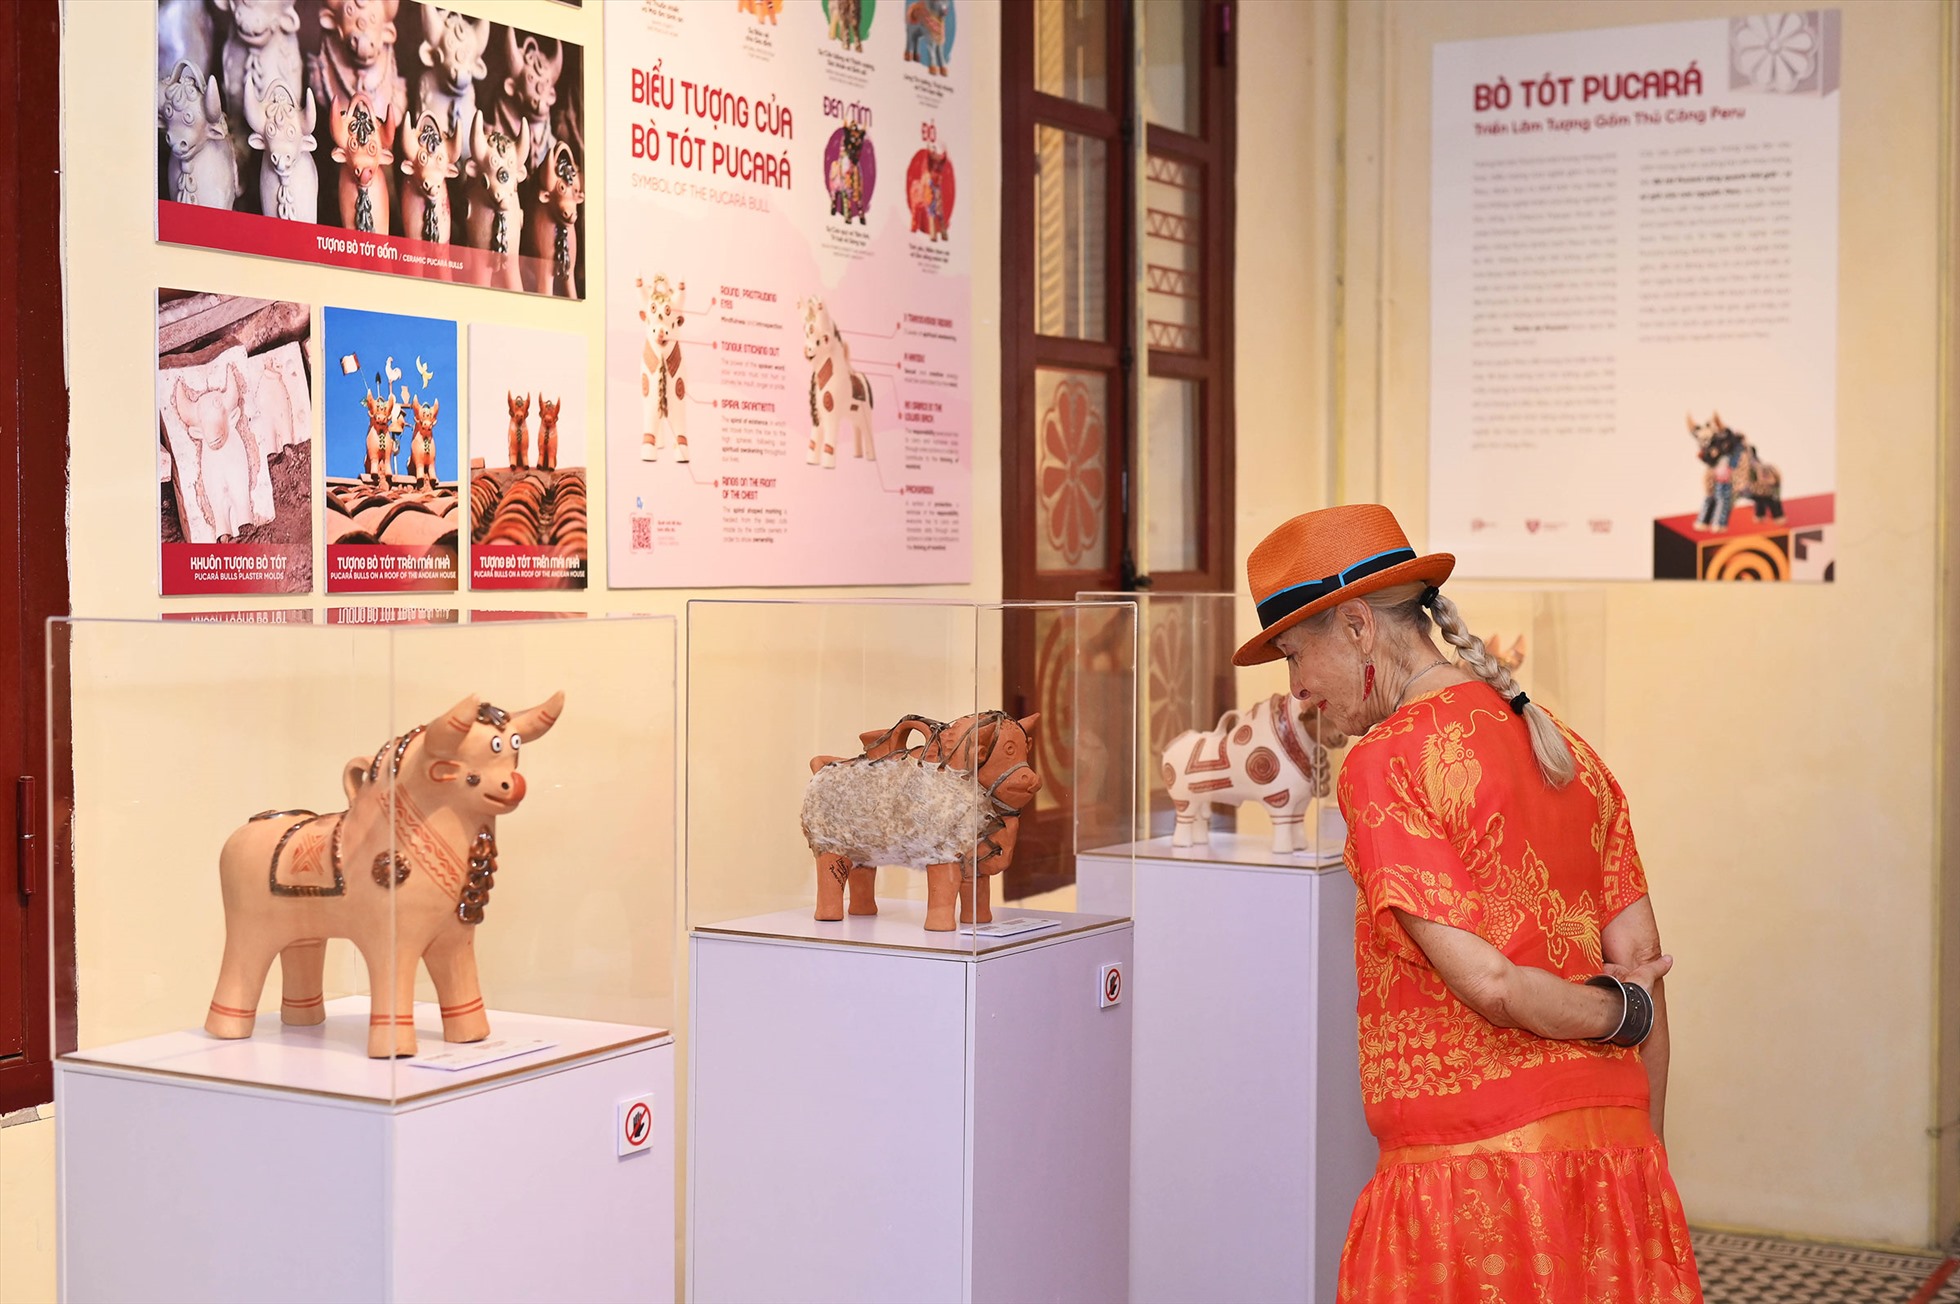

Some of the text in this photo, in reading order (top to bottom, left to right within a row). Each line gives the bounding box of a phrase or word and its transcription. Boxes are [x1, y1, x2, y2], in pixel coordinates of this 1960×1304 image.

[1474, 60, 1703, 112] BÒ TÓT PUCARÁ
[632, 58, 792, 140] BIỂU TƯỢNG CỦA
[632, 118, 791, 190] BÒ TÓT PUCARÁ
[317, 237, 345, 253] TƯỢNG
[347, 239, 358, 254] BÒ
[360, 242, 375, 257] TÓT
[377, 242, 398, 260] GỐM
[402, 254, 426, 264] CERAMIC
[448, 260, 463, 269] BULLS
[190, 554, 287, 572] KHUÔN TƯỢNG BÒ TÓT
[337, 554, 450, 571] TƯỢNG BÒ TÓT TRÊN MÁI NHÀ
[480, 556, 504, 570] TƯỢNG
[506, 554, 516, 568] BÒ
[517, 554, 531, 568] TÓT
[239, 572, 262, 580] PLASTER
[264, 572, 284, 580] MOLDS
